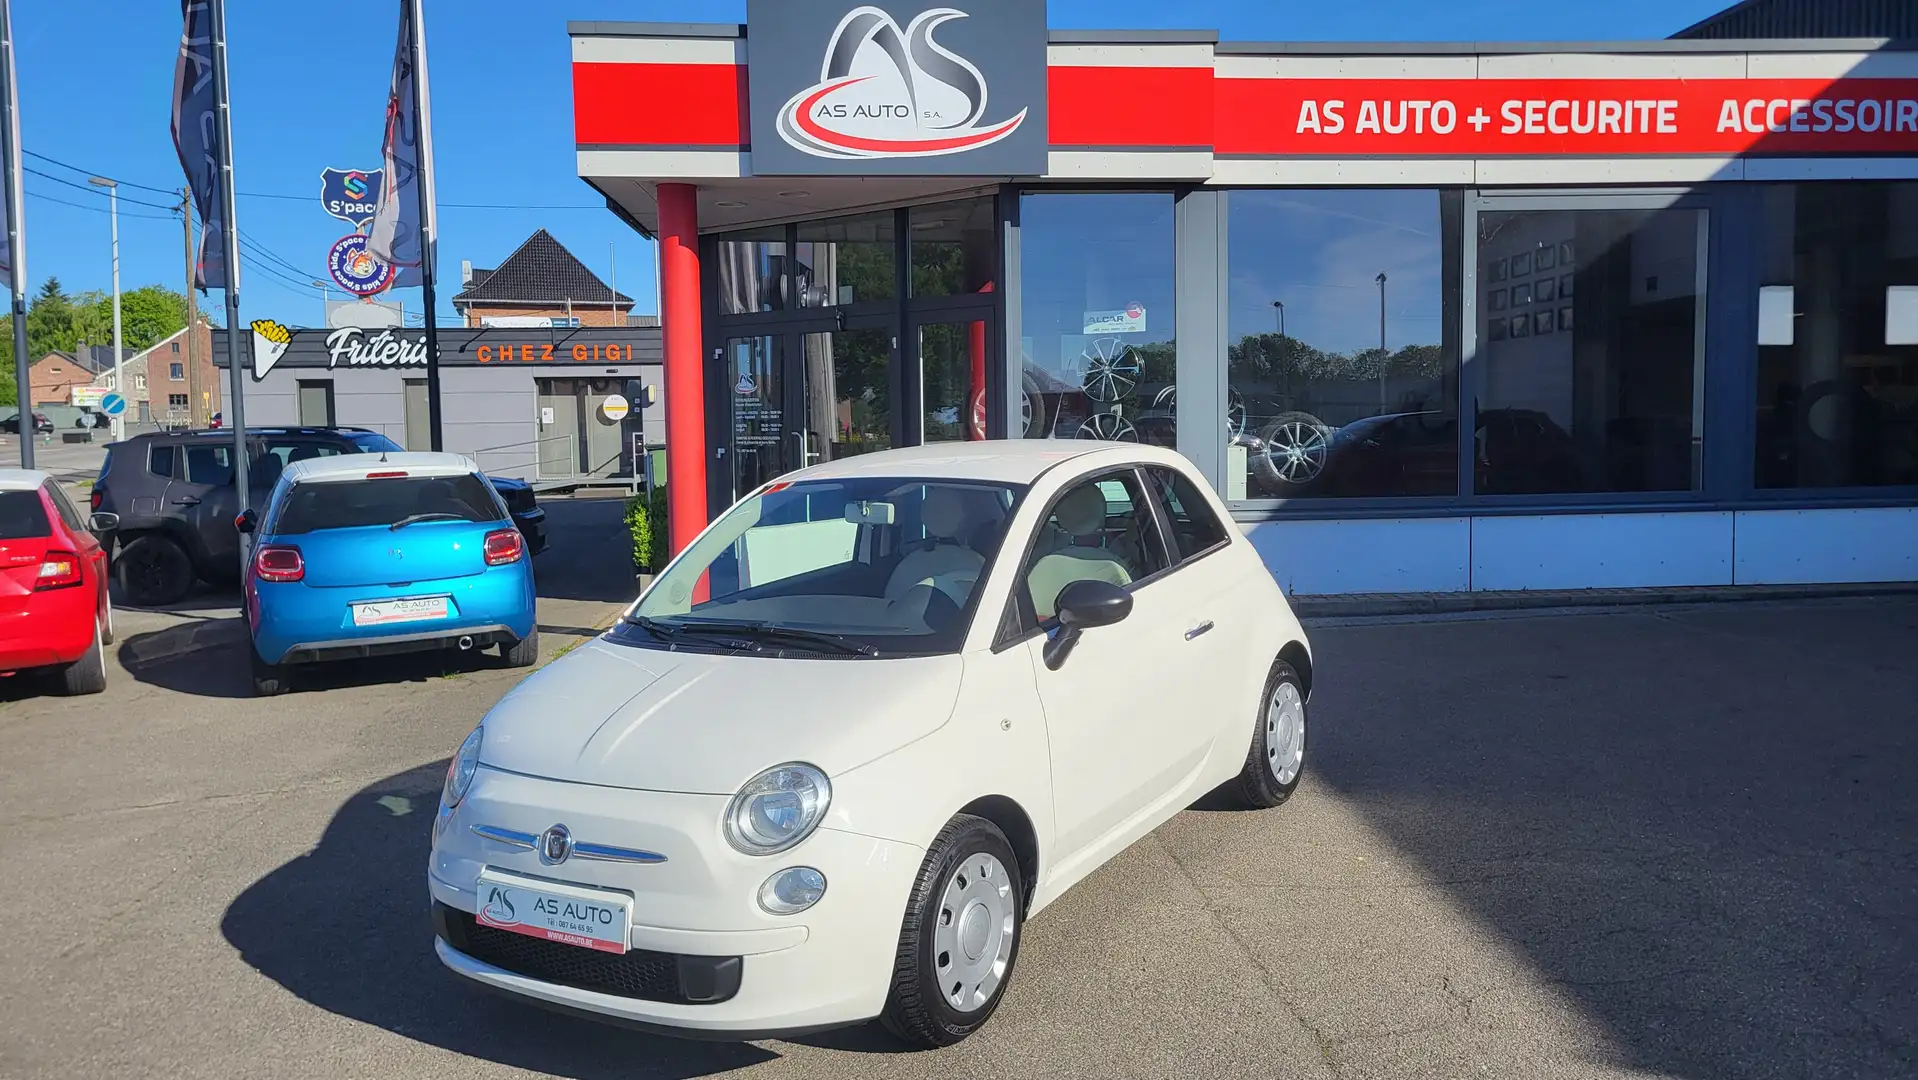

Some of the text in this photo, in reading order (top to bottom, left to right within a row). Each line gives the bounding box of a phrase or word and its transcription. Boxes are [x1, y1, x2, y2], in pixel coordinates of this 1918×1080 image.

[816, 104, 942, 119] AS AUTO S.A.
[1296, 100, 1679, 134] AS AUTO + SECURITE
[1089, 315, 1124, 323] ALCAR
[476, 344, 633, 362] CHEZ GIGI
[411, 600, 440, 608] AUTO
[533, 897, 613, 924] AS AUTO
[559, 920, 569, 929] 087
[570, 922, 577, 930] 64
